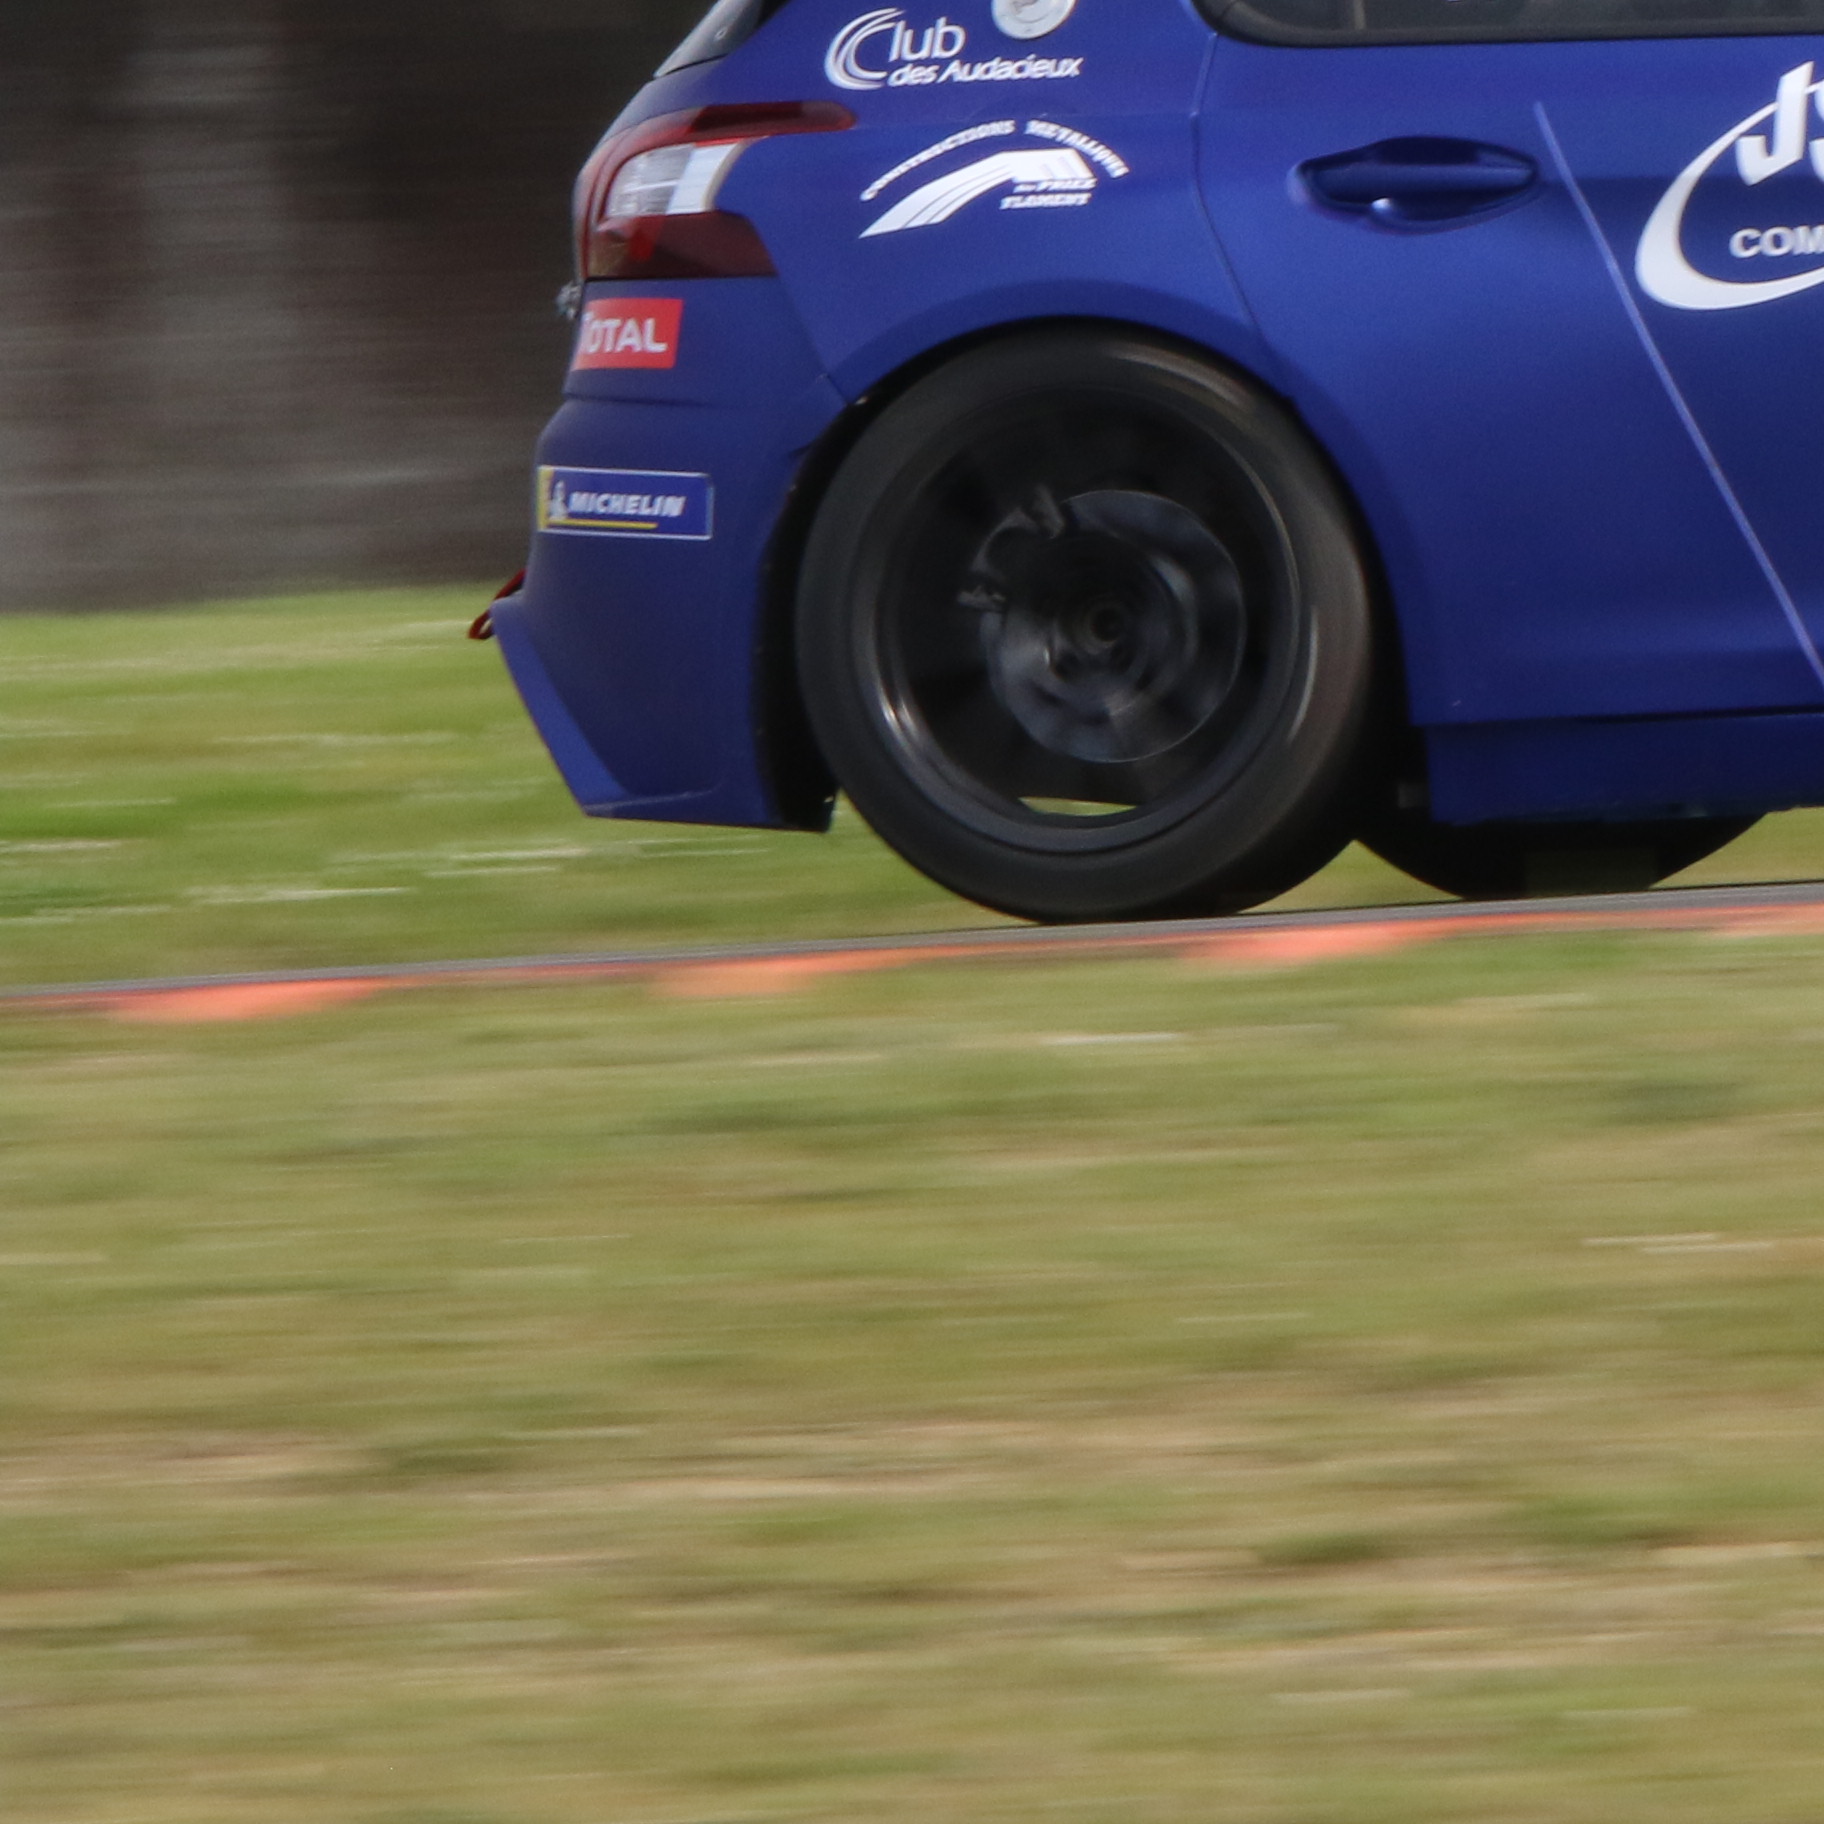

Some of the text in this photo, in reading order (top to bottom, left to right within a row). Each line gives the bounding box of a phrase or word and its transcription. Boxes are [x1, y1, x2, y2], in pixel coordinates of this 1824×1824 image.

[824, 7, 967, 90] Club
[887, 53, 1085, 87] des Audacieux
[569, 491, 687, 518] MICHELIN
